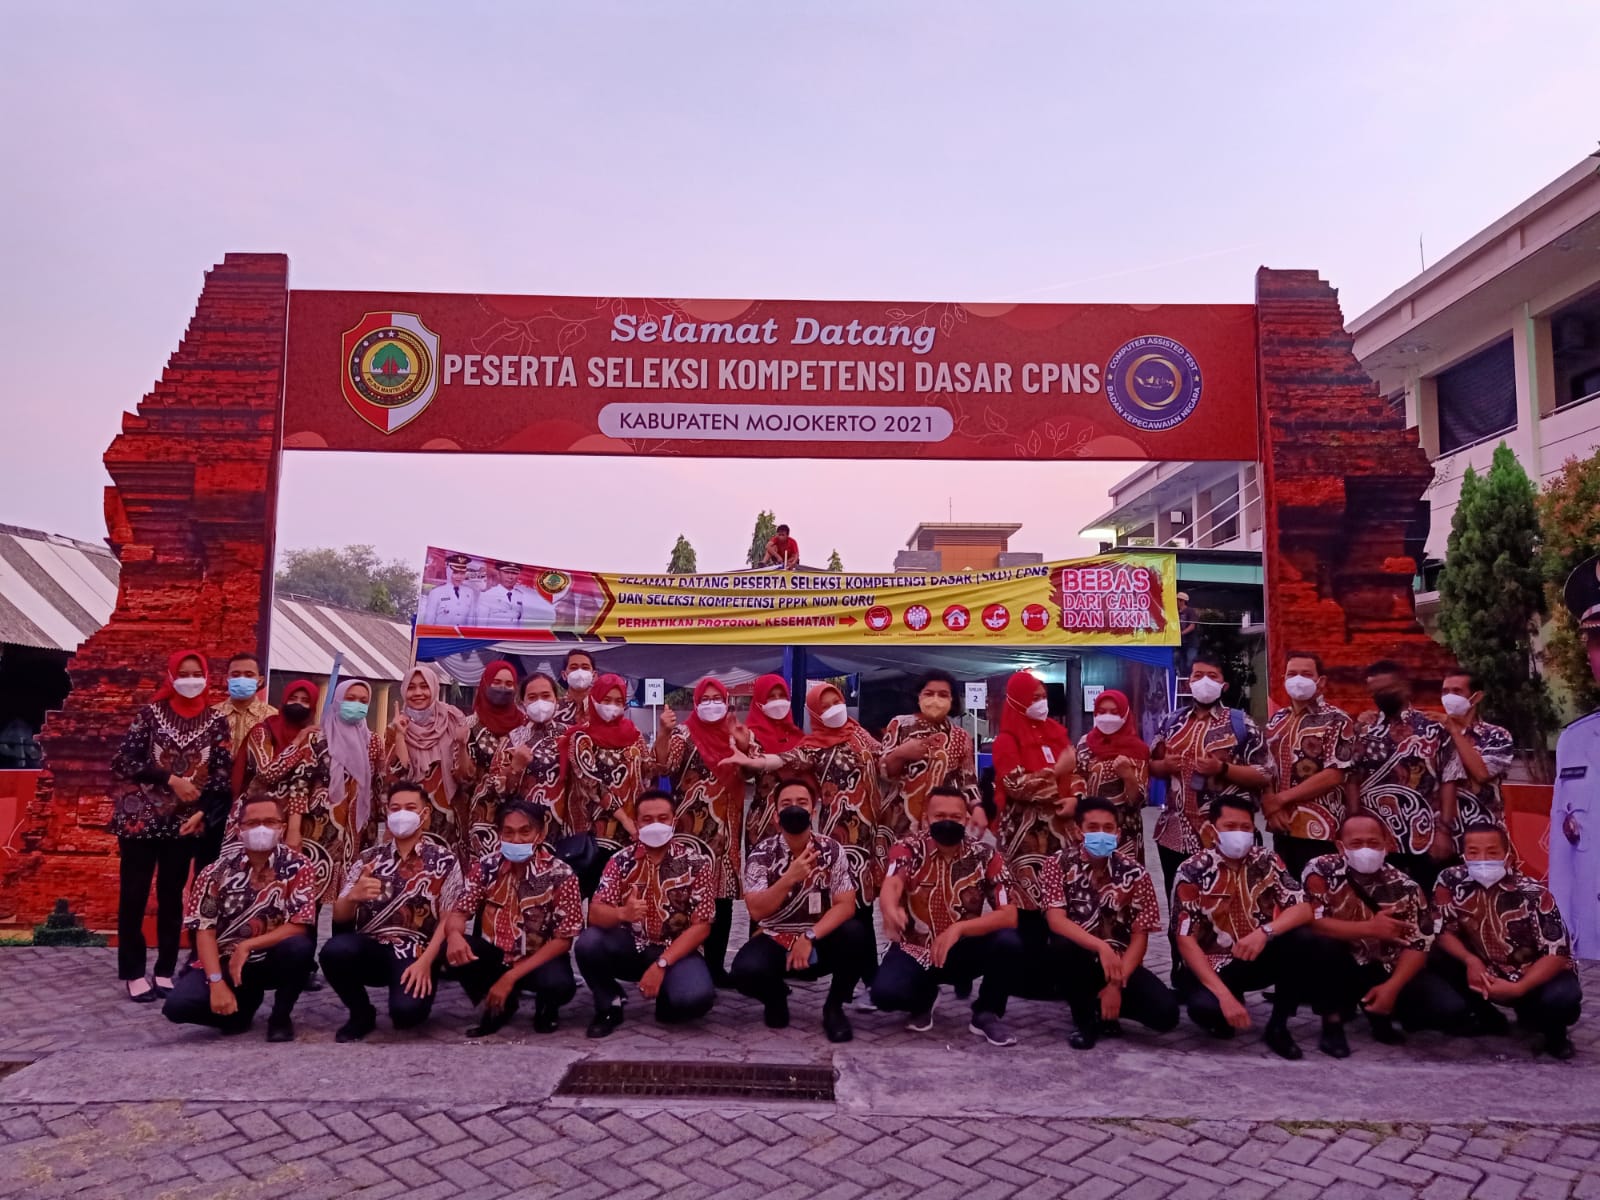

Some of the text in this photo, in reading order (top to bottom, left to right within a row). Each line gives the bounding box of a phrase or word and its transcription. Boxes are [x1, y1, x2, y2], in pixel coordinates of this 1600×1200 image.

[611, 314, 936, 354] Selamat Datang
[1109, 337, 1198, 371] COMPUTER ASSISTED TEST
[443, 354, 1101, 395] PESERTA SELEKSI KOMPETENSI DASAR CPNS
[1106, 385, 1201, 429] BADAN KEPEGAWAIAN NEGARA
[620, 412, 932, 433] KABUPATEN MOJOKERTO 2021
[678, 576, 729, 589] DATANG
[733, 576, 787, 590] PESERTA
[791, 576, 842, 590] SELEKSI
[846, 576, 926, 590] KOMPETENSI
[930, 574, 972, 586] DASAR
[1062, 568, 1151, 593] BEBAS
[646, 594, 695, 607] SELEKSI
[698, 595, 775, 609] KOMPETENSI
[778, 597, 808, 609] PPPK
[812, 596, 838, 607] NON
[841, 595, 876, 606] GURU
[1063, 593, 1150, 610] DARI CALO
[618, 616, 836, 628] PERHATIKAN PROTOKOL KESEHATAN
[1063, 610, 1150, 628] DAN KKN
